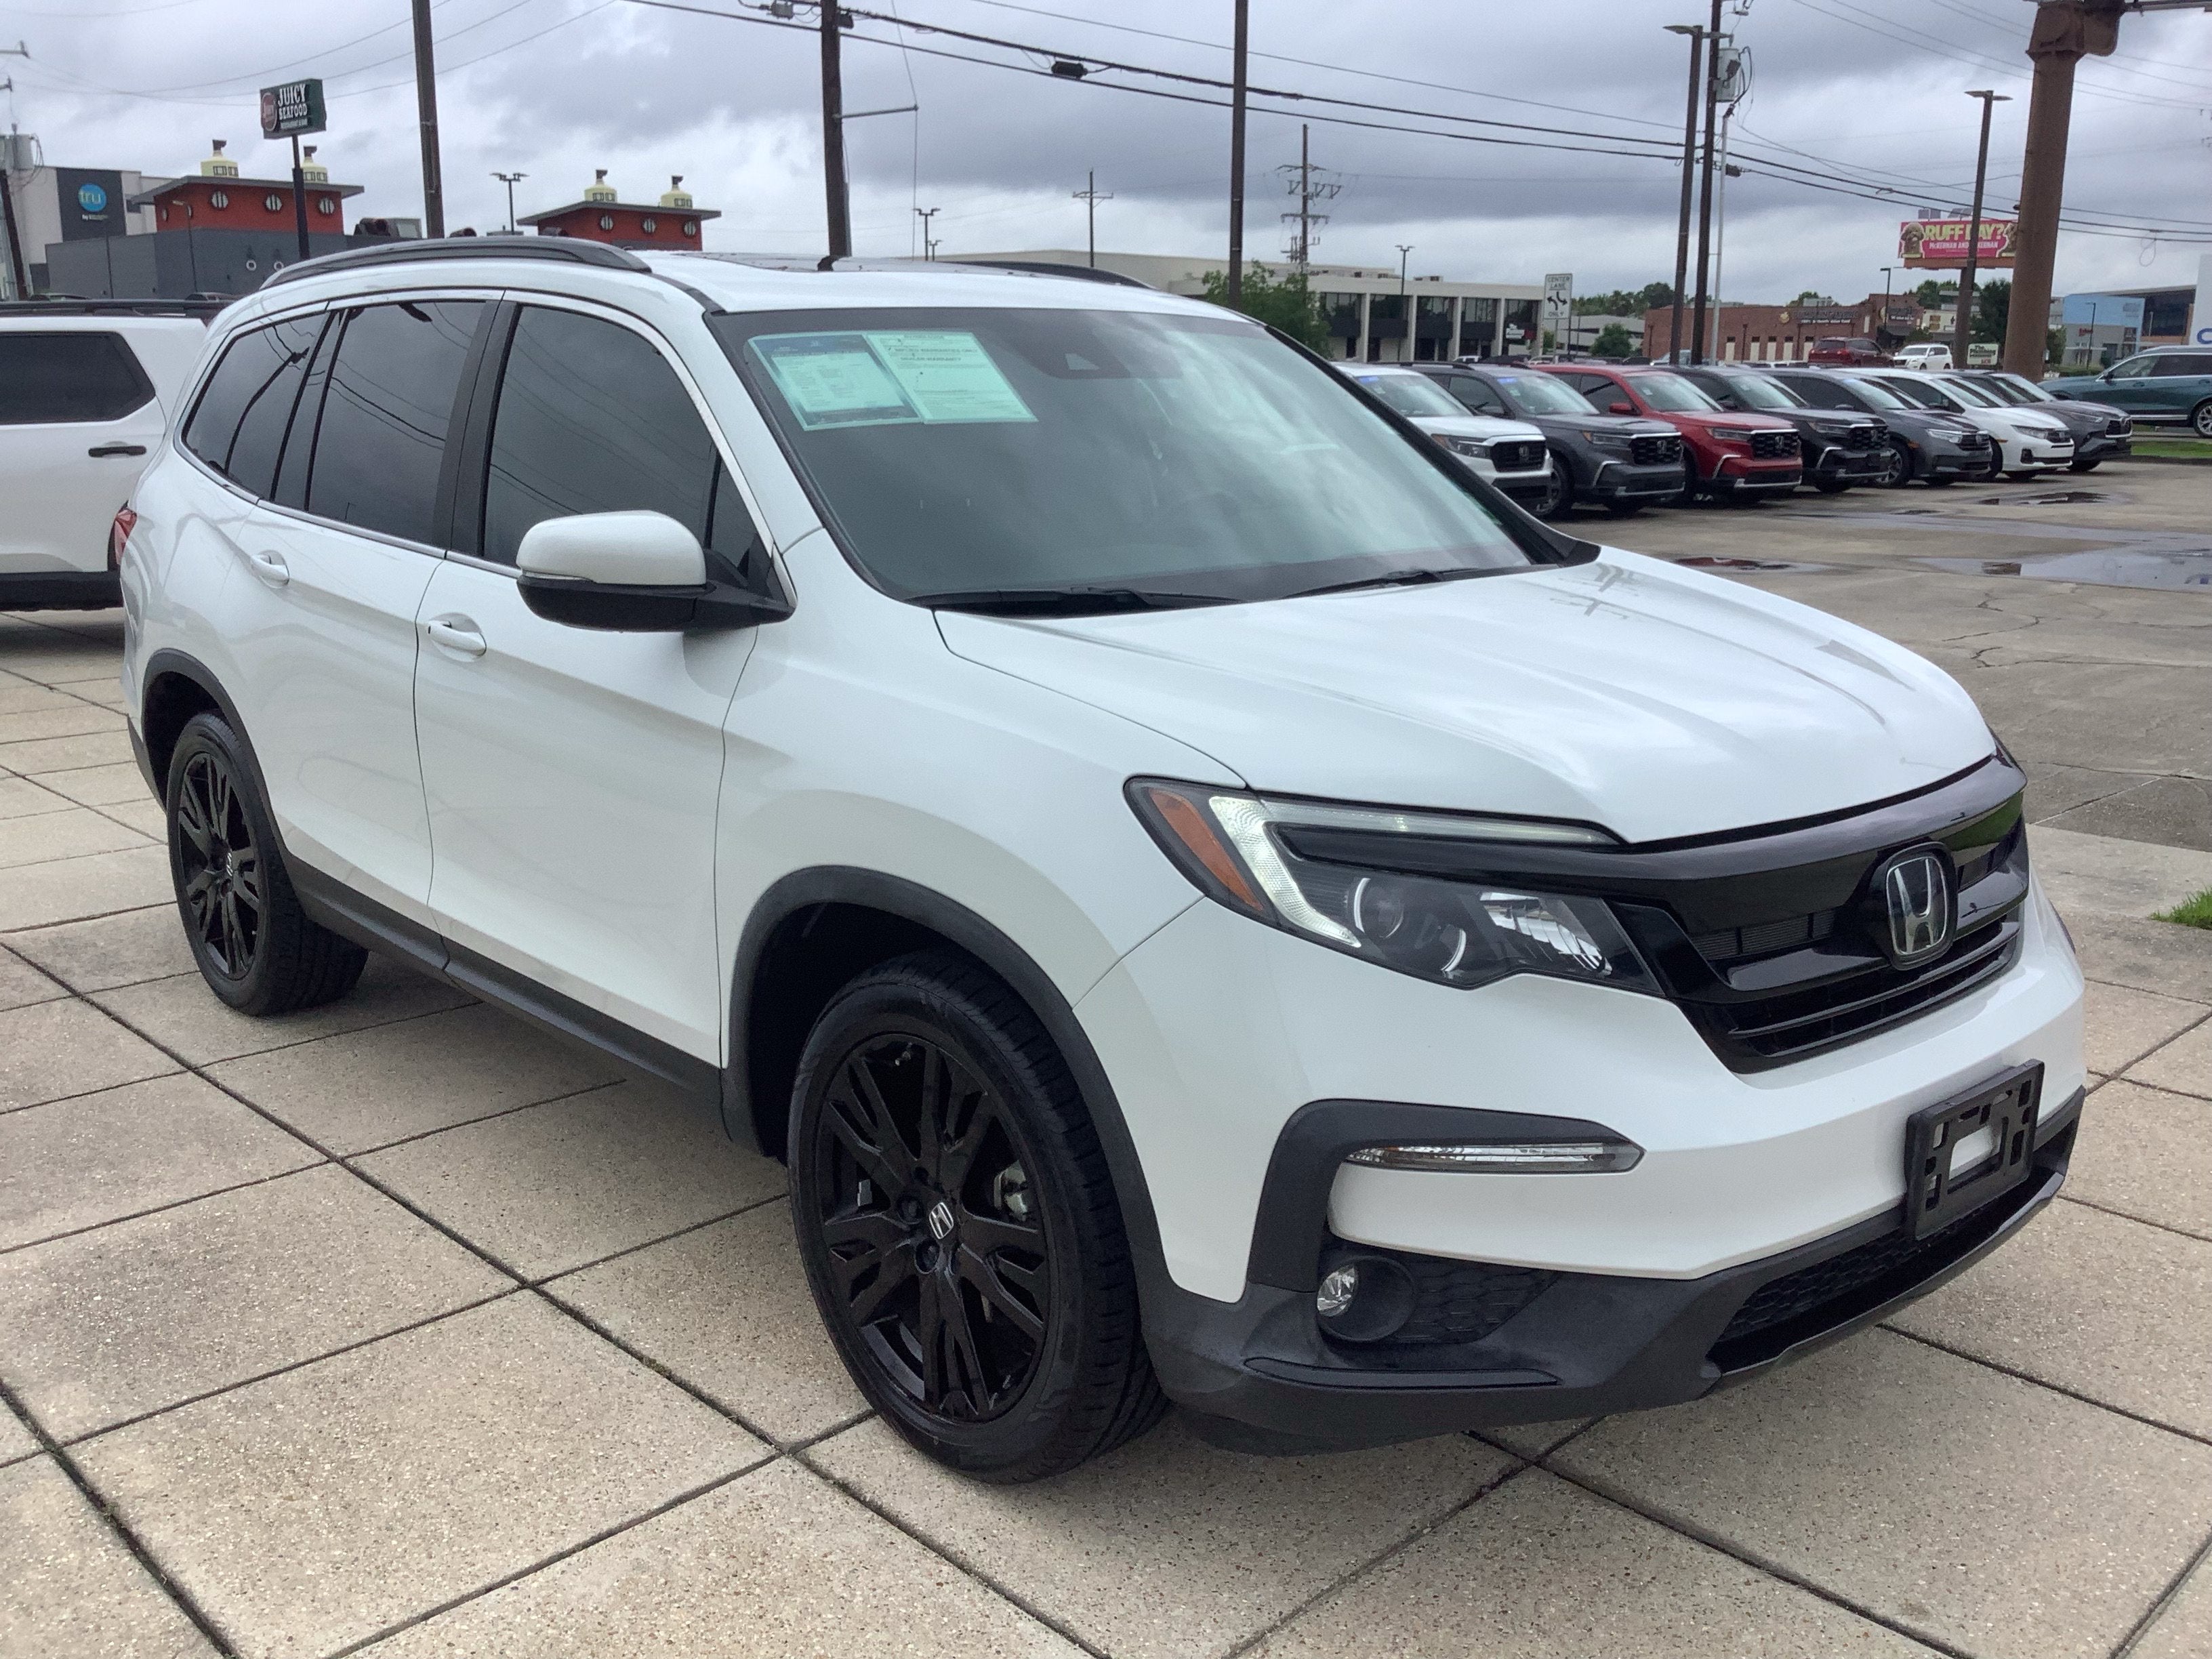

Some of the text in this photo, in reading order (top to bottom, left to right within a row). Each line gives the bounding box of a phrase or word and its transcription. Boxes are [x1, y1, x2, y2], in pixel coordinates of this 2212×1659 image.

[277, 83, 306, 107] JUICY
[279, 103, 308, 121] SEAFOOD
[78, 189, 101, 205] tru
[1924, 224, 1965, 241] RUFF
